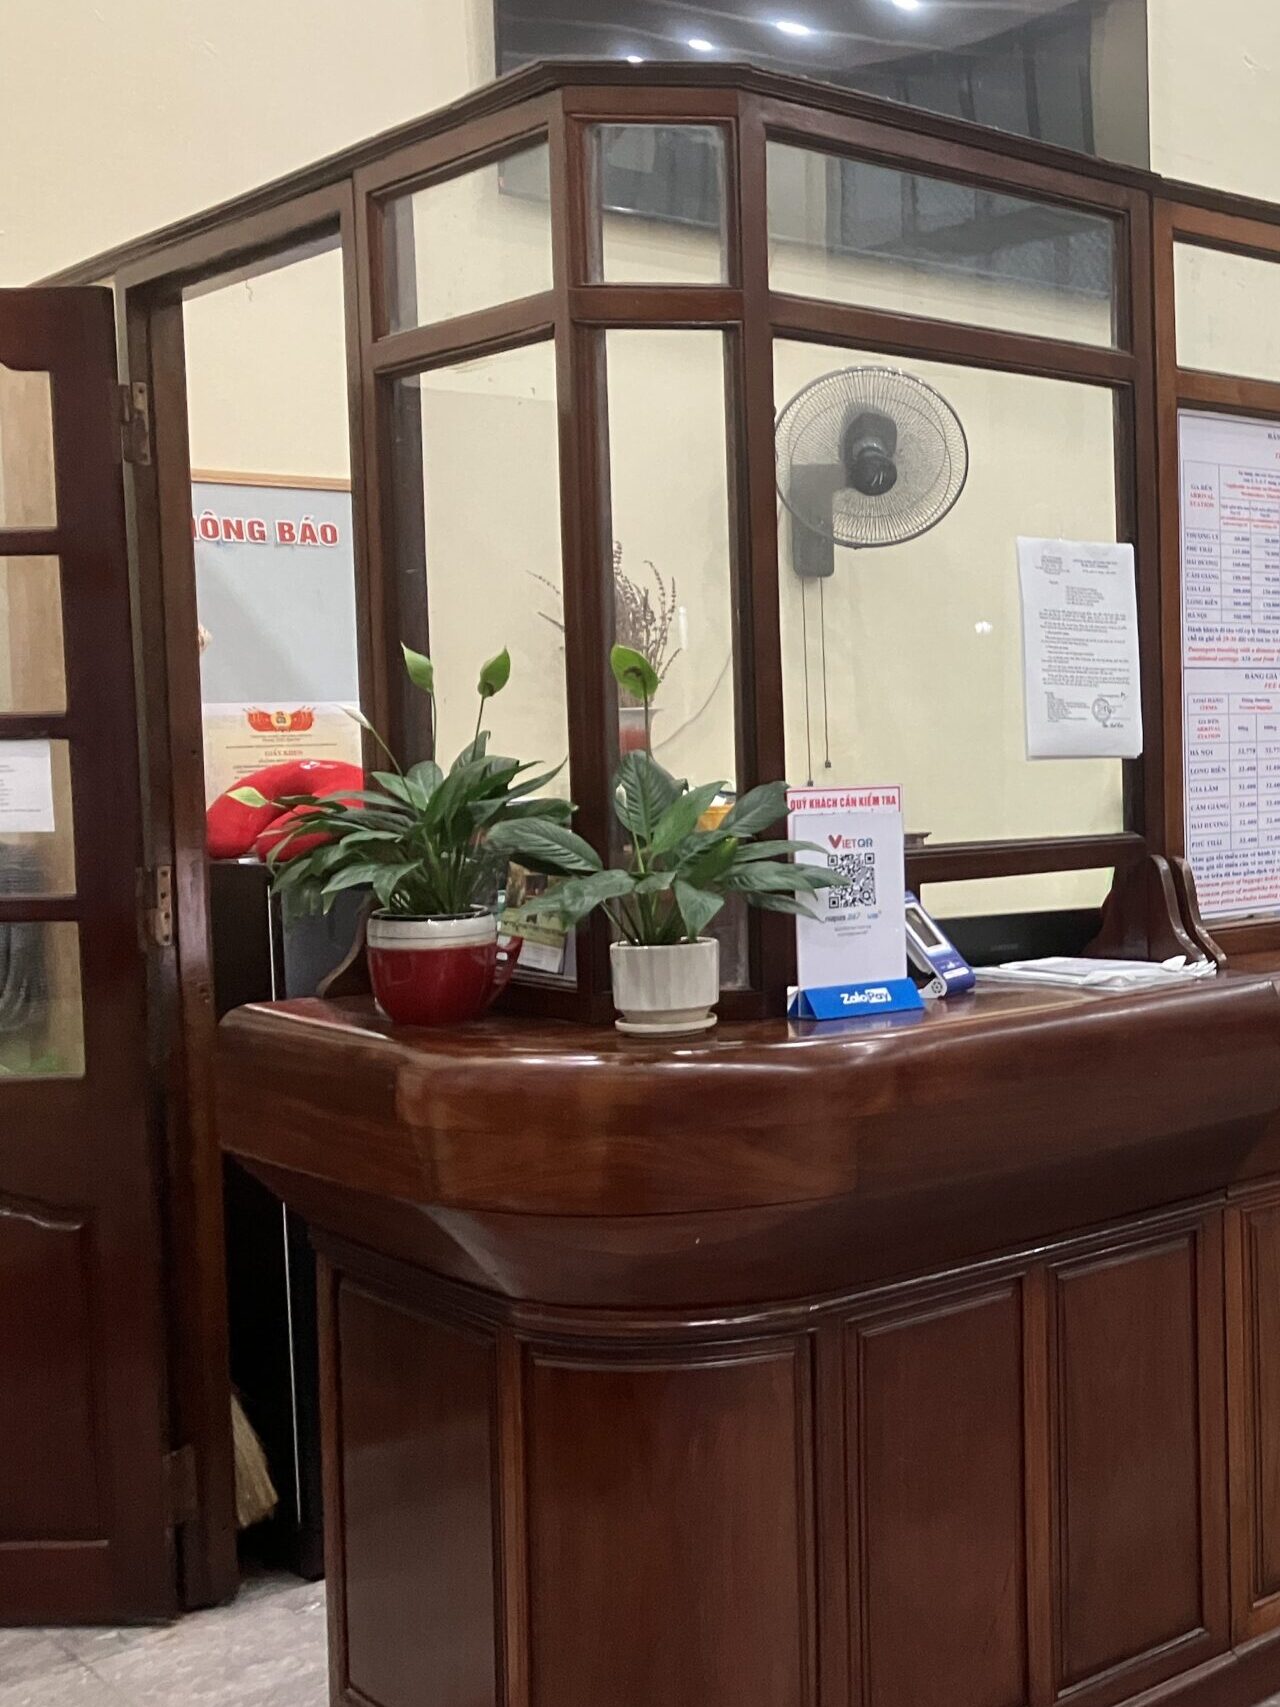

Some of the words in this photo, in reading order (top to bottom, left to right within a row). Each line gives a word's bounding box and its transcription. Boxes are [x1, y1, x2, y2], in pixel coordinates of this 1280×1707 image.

[276, 514, 339, 546] BÁO
[790, 797, 807, 810] QUÝ
[809, 795, 838, 809] KHÁCH
[839, 793, 857, 808] CẦN
[859, 792, 880, 807] KIỂM
[881, 795, 897, 805] TRA
[839, 987, 892, 1005] ZaloPay
